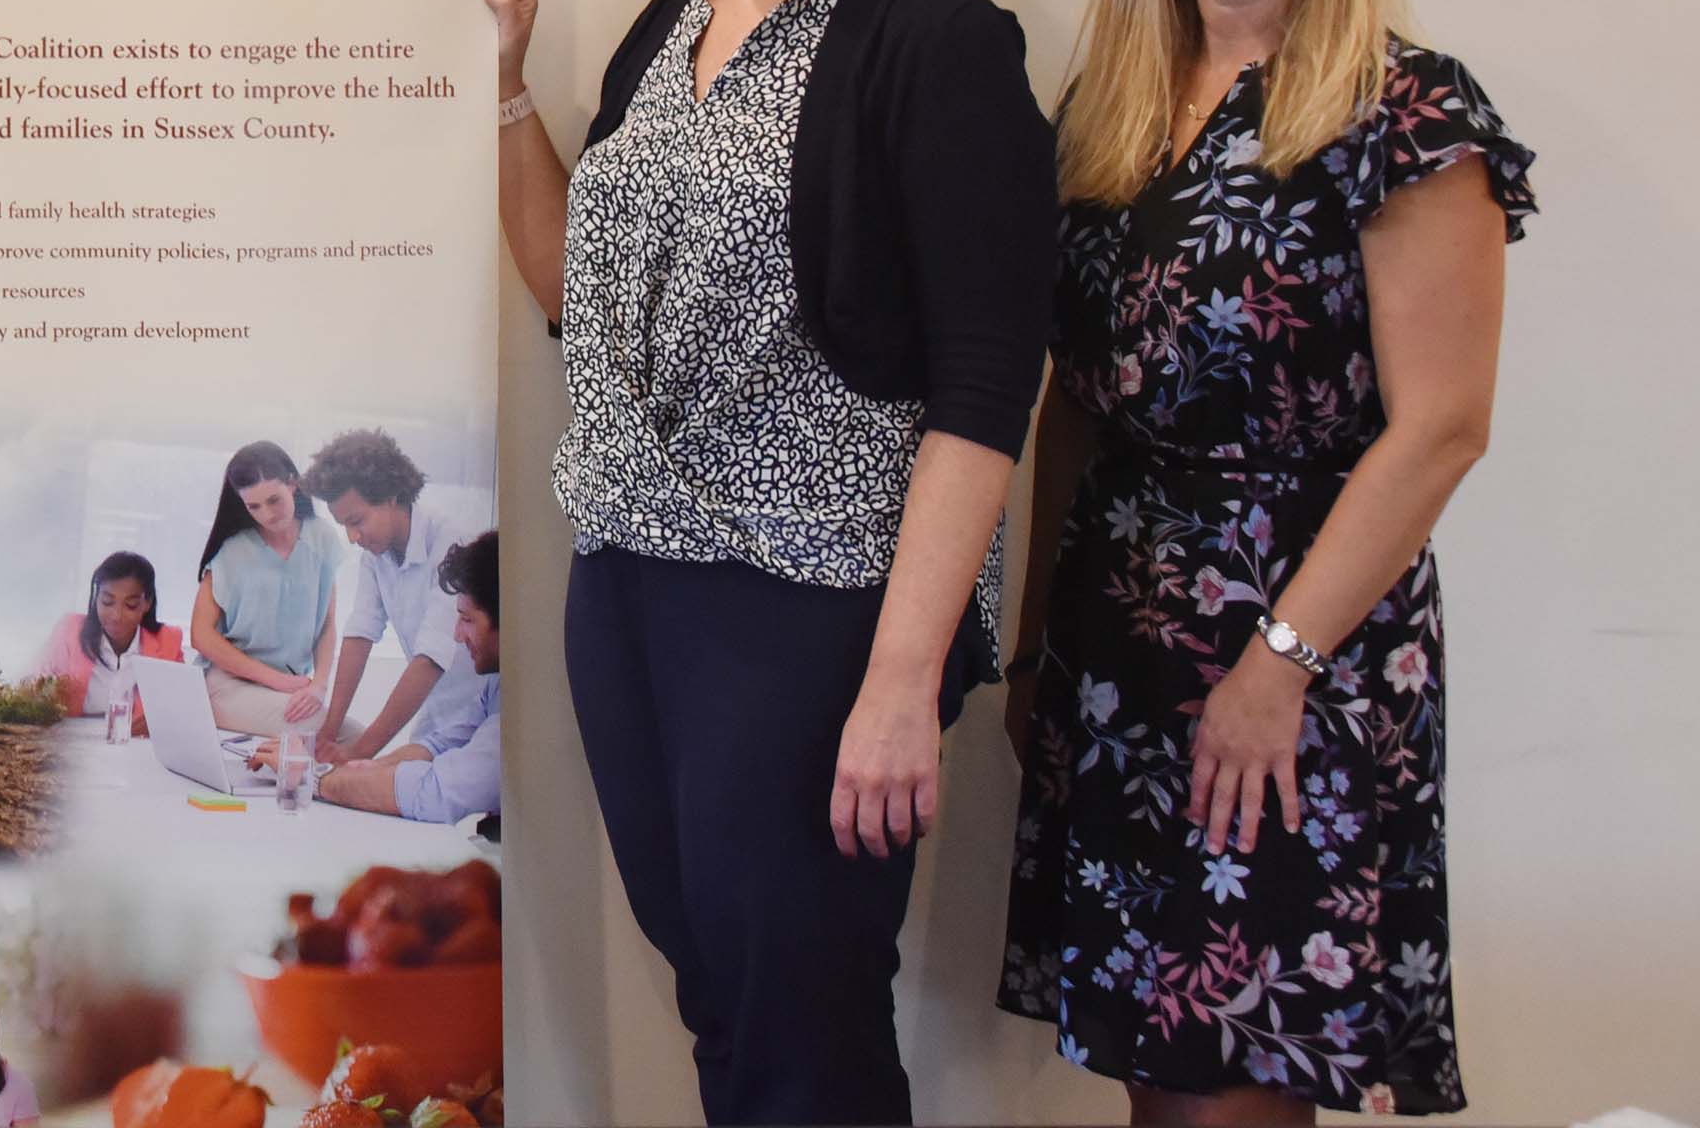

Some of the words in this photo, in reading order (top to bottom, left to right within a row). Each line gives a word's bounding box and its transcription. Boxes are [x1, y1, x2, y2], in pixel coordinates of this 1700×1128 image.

[112, 38, 180, 60] exists
[188, 41, 213, 60] to
[219, 43, 298, 65] engage
[304, 35, 341, 60] the
[348, 37, 415, 60] entire
[135, 75, 204, 100] effort
[211, 81, 235, 100] to
[243, 77, 336, 105] improve
[343, 74, 380, 99] the
[387, 74, 457, 99] health
[20, 115, 114, 140] families
[121, 117, 145, 140] in
[153, 116, 236, 140] Sussex
[243, 116, 336, 145] County.
[8, 200, 64, 223] family
[68, 200, 127, 220] health
[131, 202, 216, 224] strategies
[49, 241, 152, 263] community
[156, 240, 231, 264] policies,
[236, 246, 318, 264] programs
[322, 239, 355, 258] and
[359, 239, 434, 262] practices
[1, 286, 86, 300] resources
[13, 319, 48, 340] and
[51, 326, 129, 343] program
[133, 319, 250, 344] development
